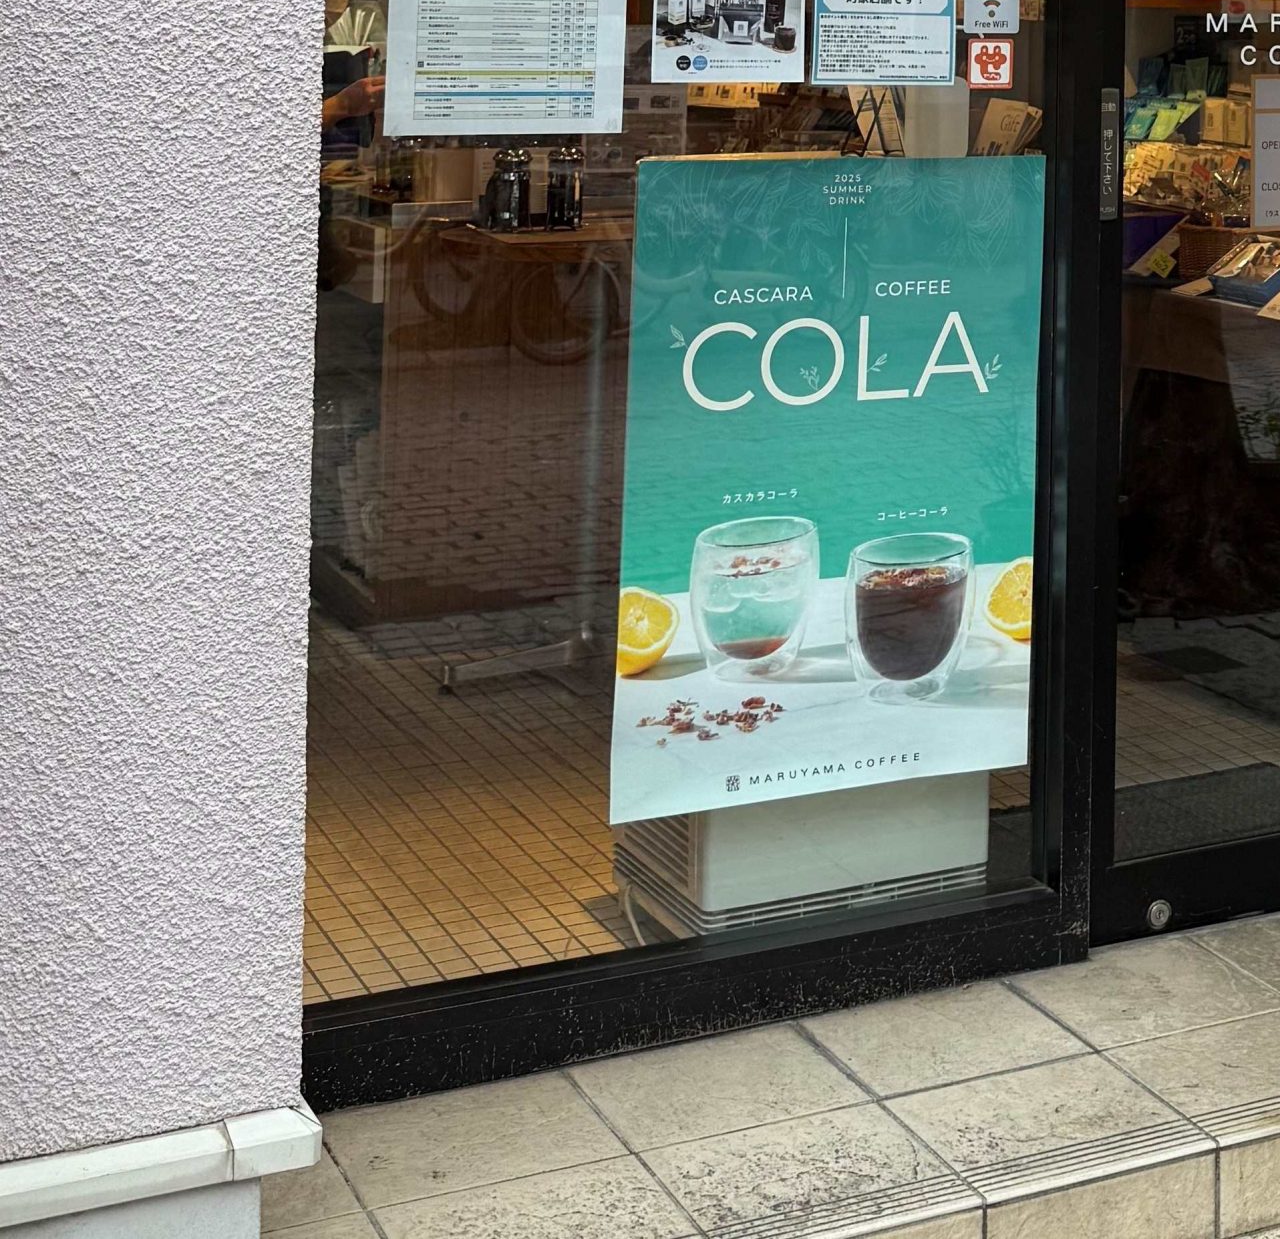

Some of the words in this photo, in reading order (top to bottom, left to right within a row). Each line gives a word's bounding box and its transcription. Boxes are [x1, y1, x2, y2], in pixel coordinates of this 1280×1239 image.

[974, 20, 991, 29] Free
[992, 20, 1009, 29] WiFi
[833, 173, 862, 183] 2025
[822, 184, 873, 195] SUMMER
[828, 195, 867, 206] DRINK
[713, 286, 814, 306] CASCARA
[874, 279, 952, 297] COFFEE
[682, 311, 990, 412] COLA
[722, 488, 799, 505] カスカラコーラ
[876, 506, 949, 521] コーヒーコーラ
[748, 762, 846, 786] MARUYAMA
[854, 751, 921, 771] COFFEE
